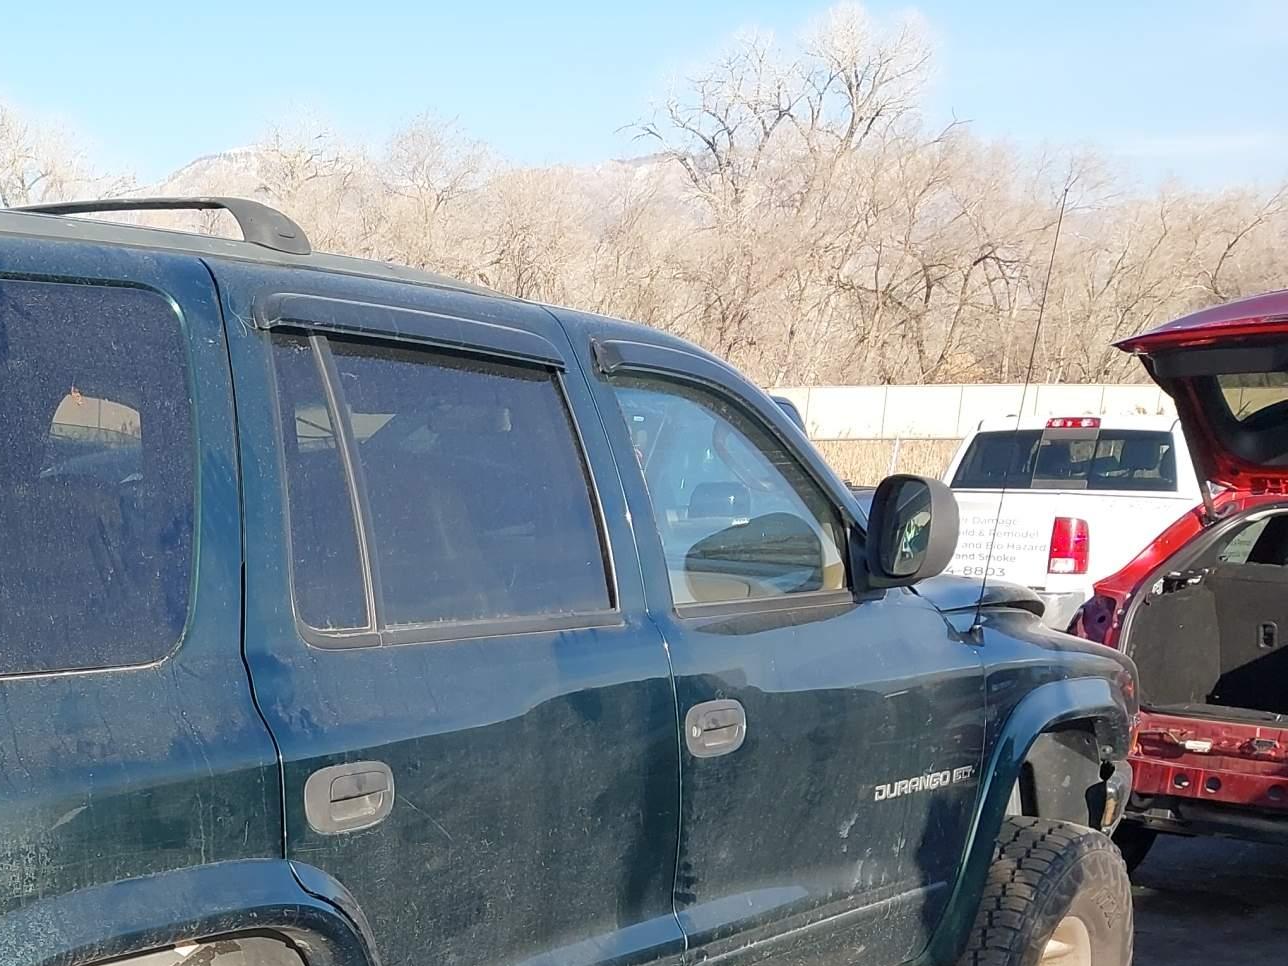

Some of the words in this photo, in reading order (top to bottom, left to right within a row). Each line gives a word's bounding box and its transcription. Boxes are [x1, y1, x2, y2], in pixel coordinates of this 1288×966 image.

[985, 541, 1004, 550] Bio
[1007, 542, 1047, 552] Hazard
[955, 552, 975, 561] and
[978, 552, 1016, 562] Smoke
[874, 770, 951, 801] DURANGO
